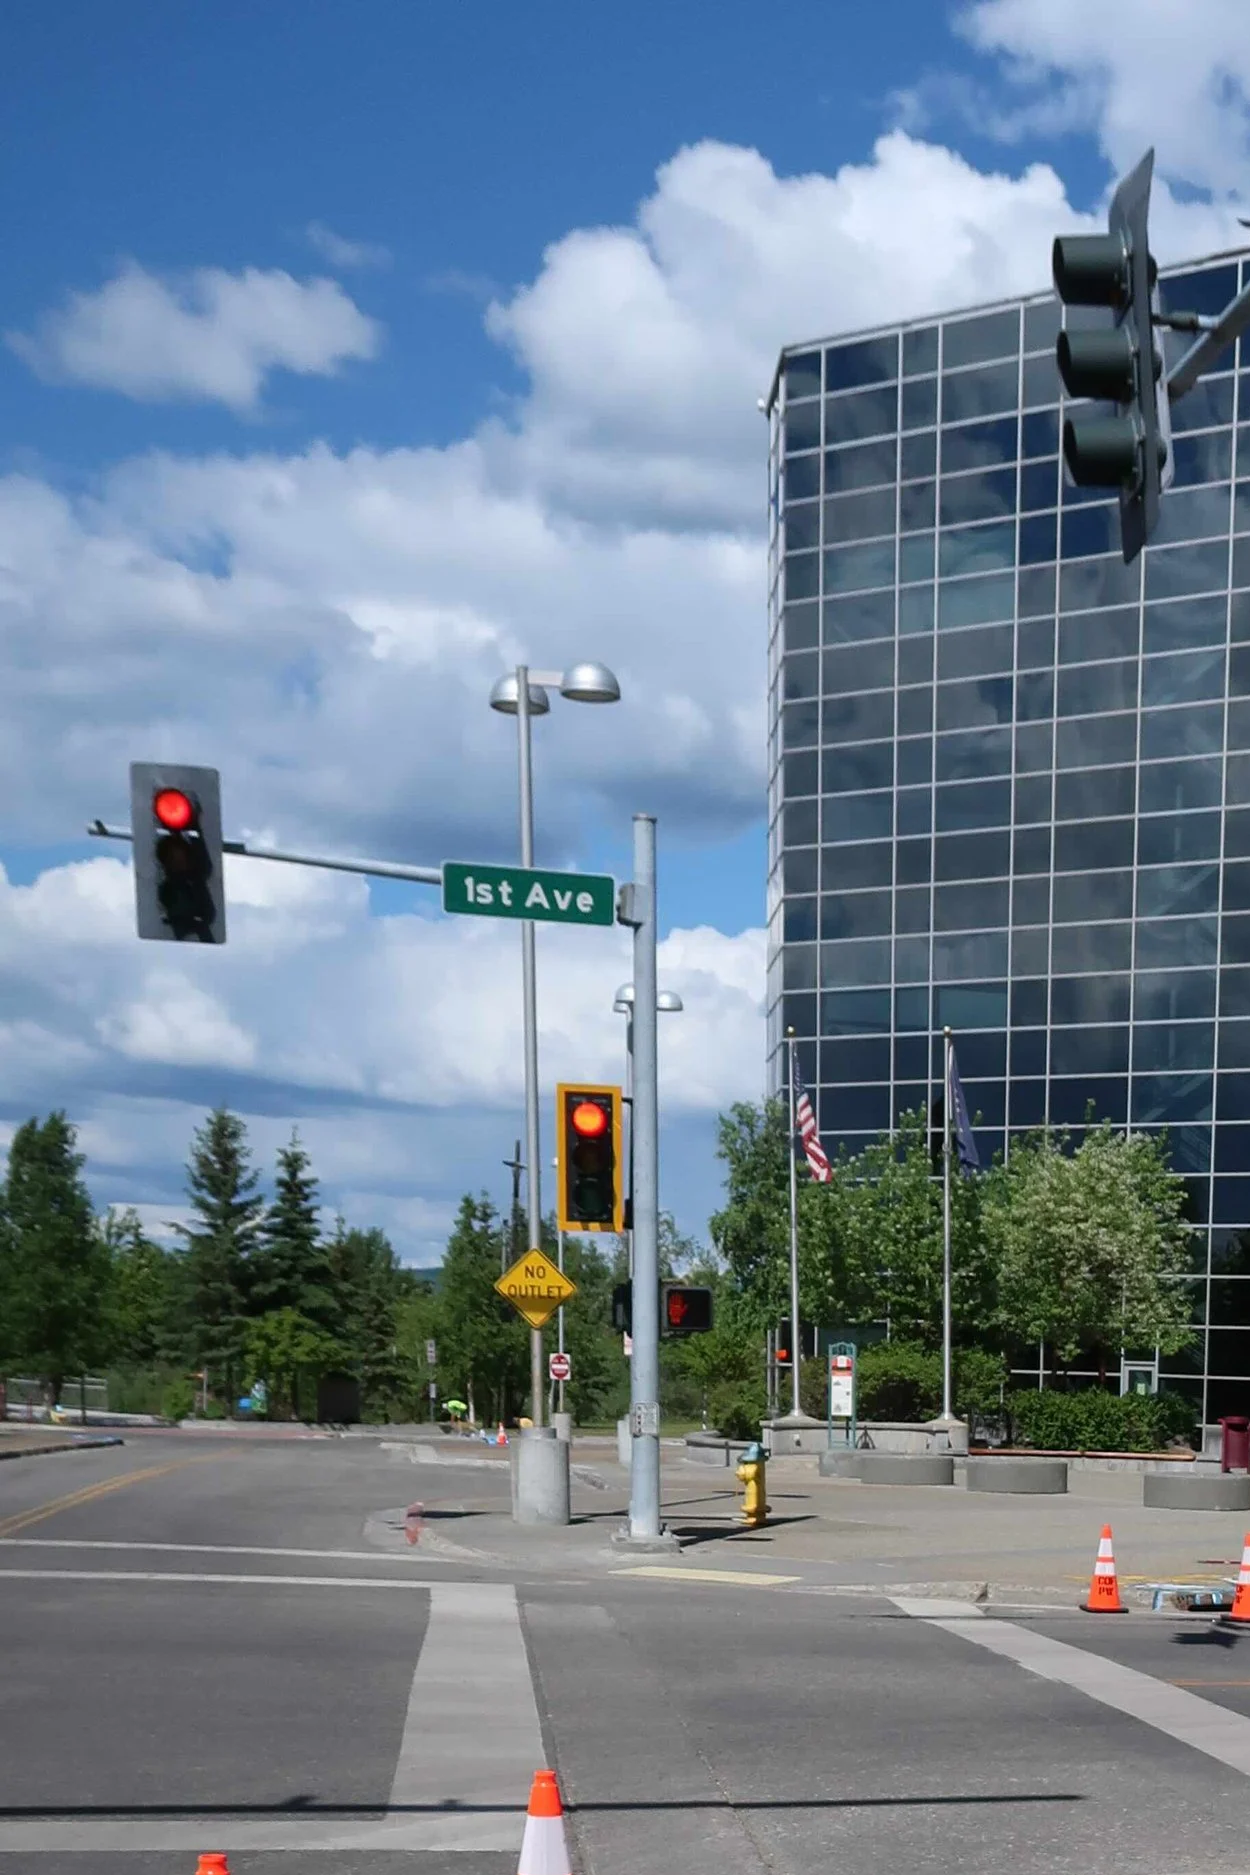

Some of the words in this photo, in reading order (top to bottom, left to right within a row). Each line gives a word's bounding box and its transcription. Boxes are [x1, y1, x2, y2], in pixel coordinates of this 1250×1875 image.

[463, 876, 514, 906] 1st
[524, 882, 595, 913] Ave
[524, 1265, 546, 1279] NO
[507, 1284, 563, 1299] OUTLET
